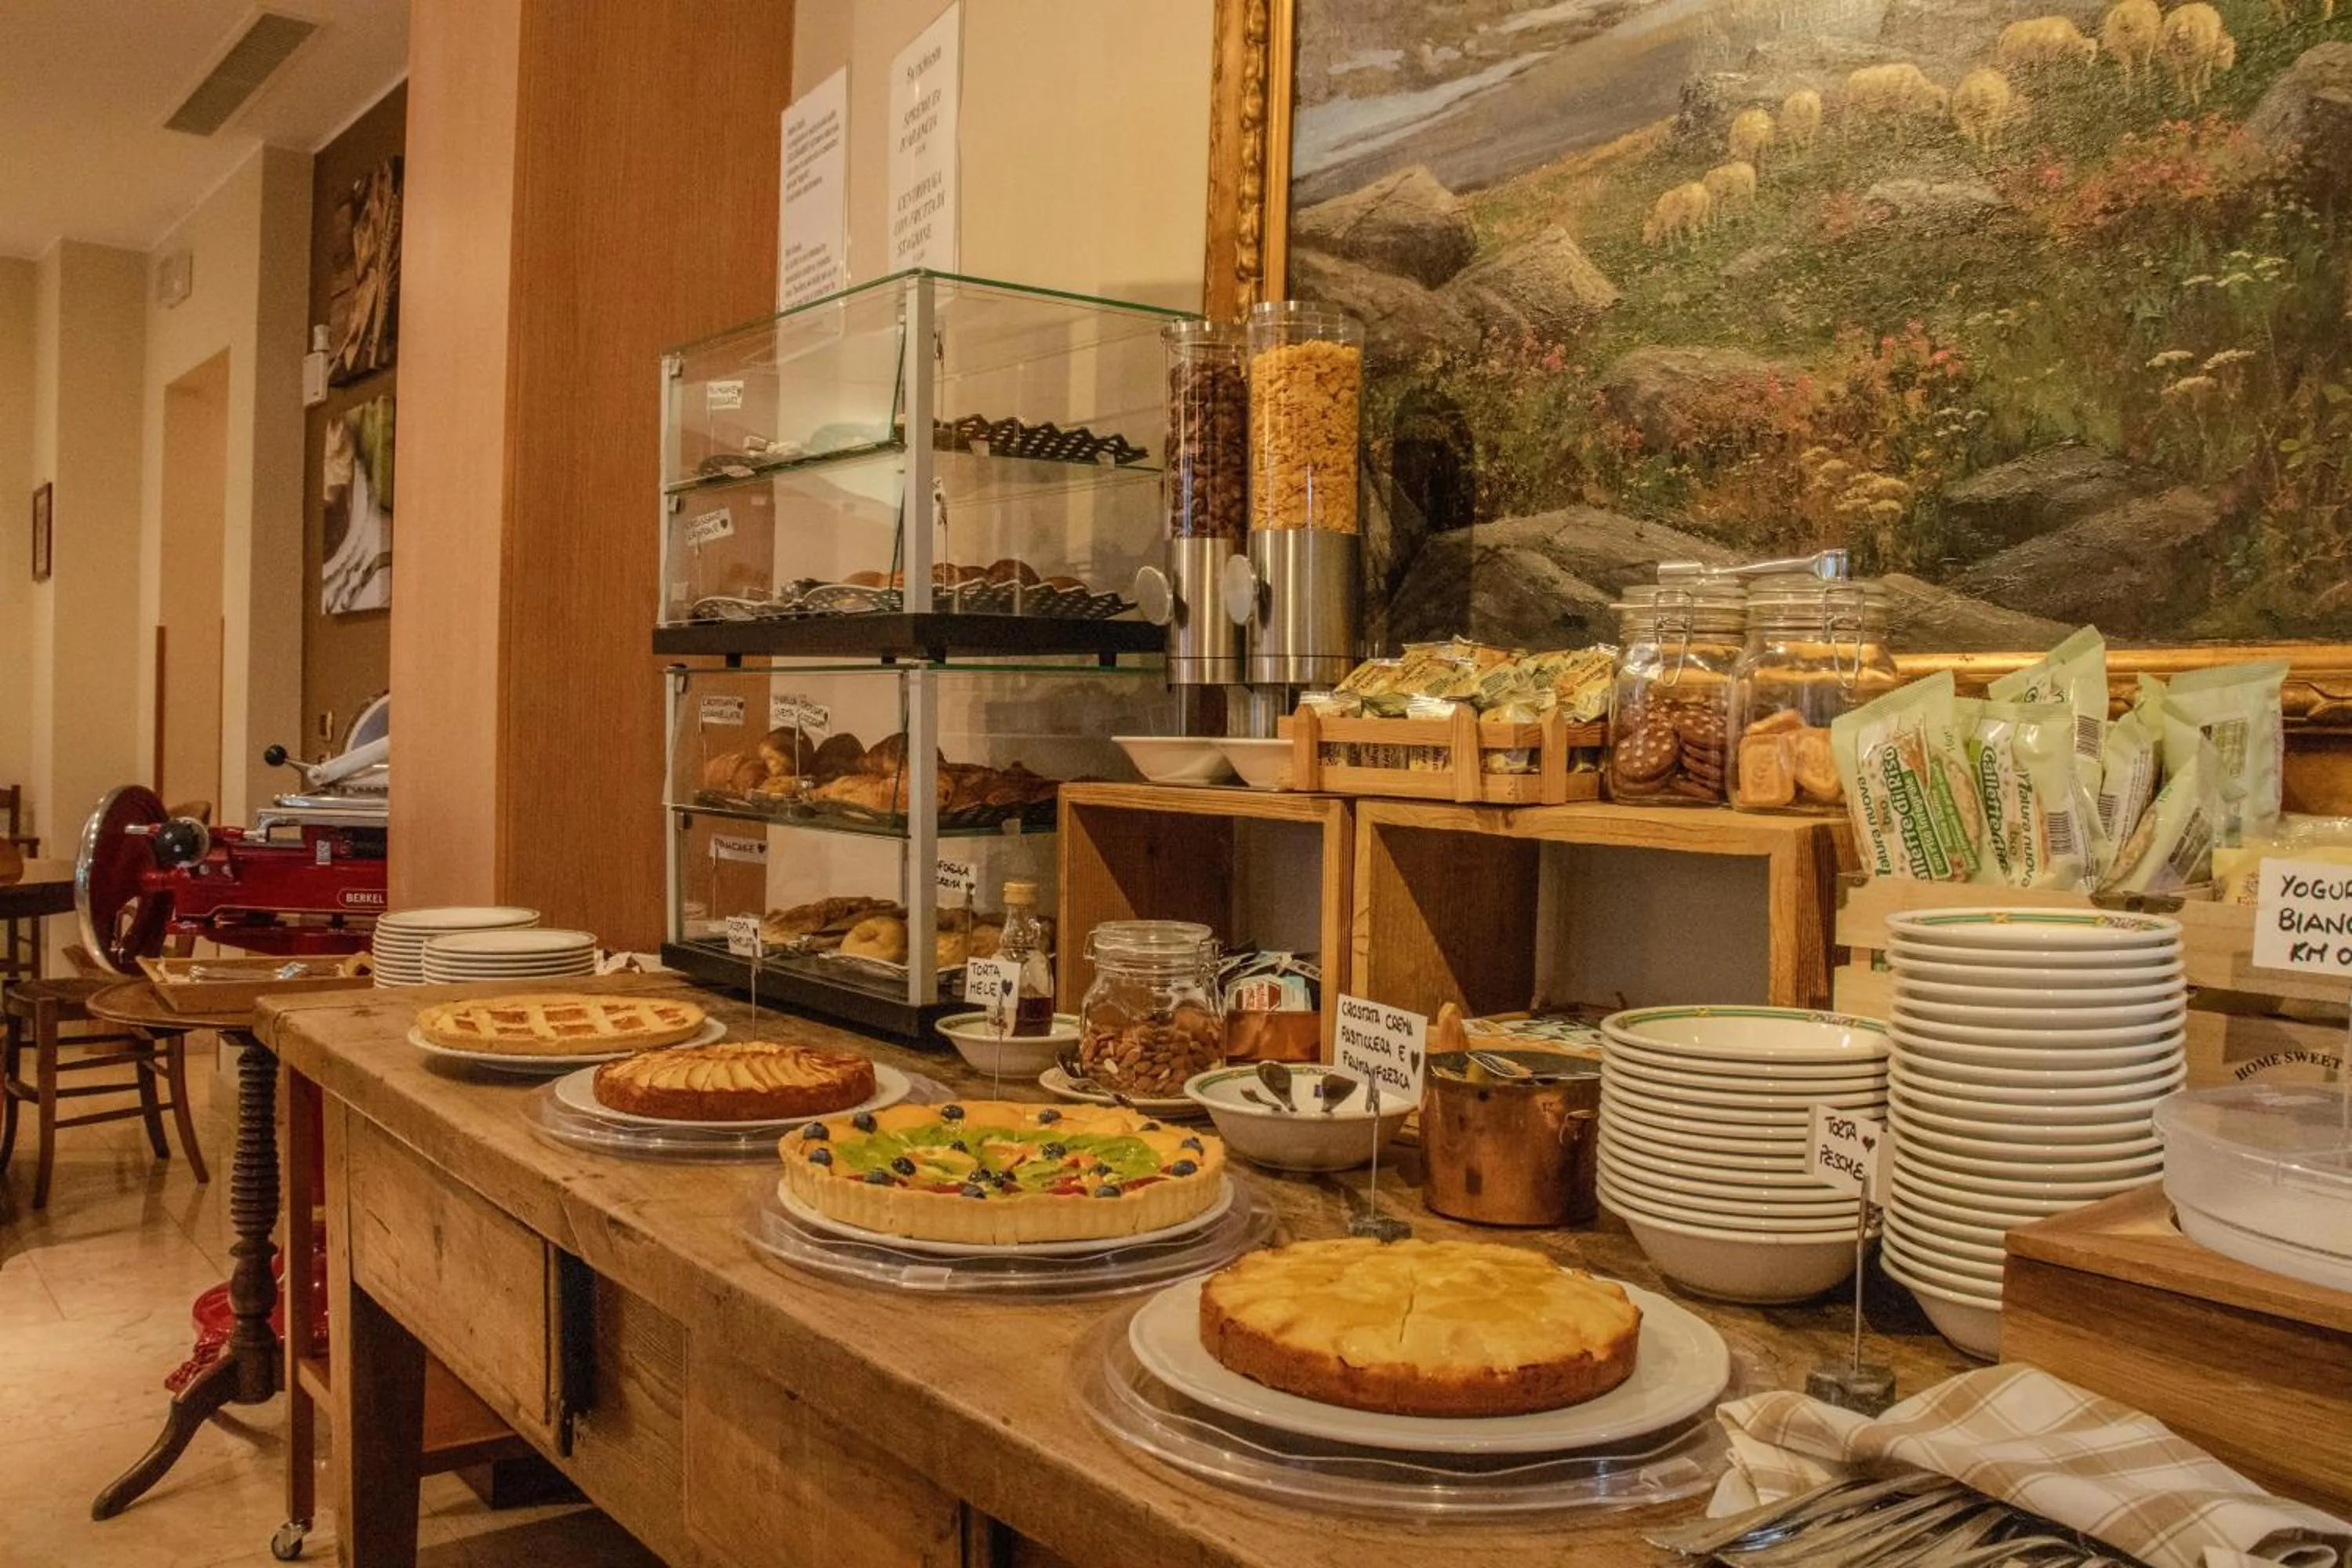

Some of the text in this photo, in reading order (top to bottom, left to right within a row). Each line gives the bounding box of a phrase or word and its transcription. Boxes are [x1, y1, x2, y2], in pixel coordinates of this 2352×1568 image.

[1881, 746, 1904, 791] Riso
[1857, 776, 1878, 826] nuova
[1981, 746, 2002, 833] Gallette
[1900, 817, 1930, 883] allette
[2021, 834, 2034, 887] nuova
[346, 893, 385, 904] BERKEL
[971, 962, 1001, 978] TORTA
[1342, 1001, 1413, 1036] CROSTATA CREMA
[1398, 1044, 1406, 1062] E
[2234, 1051, 2343, 1081] HOME SWEET
[1376, 1065, 1410, 1091] FRESCA
[1824, 1116, 1857, 1142] TORTA
[1820, 1144, 1864, 1181] PESCHE
